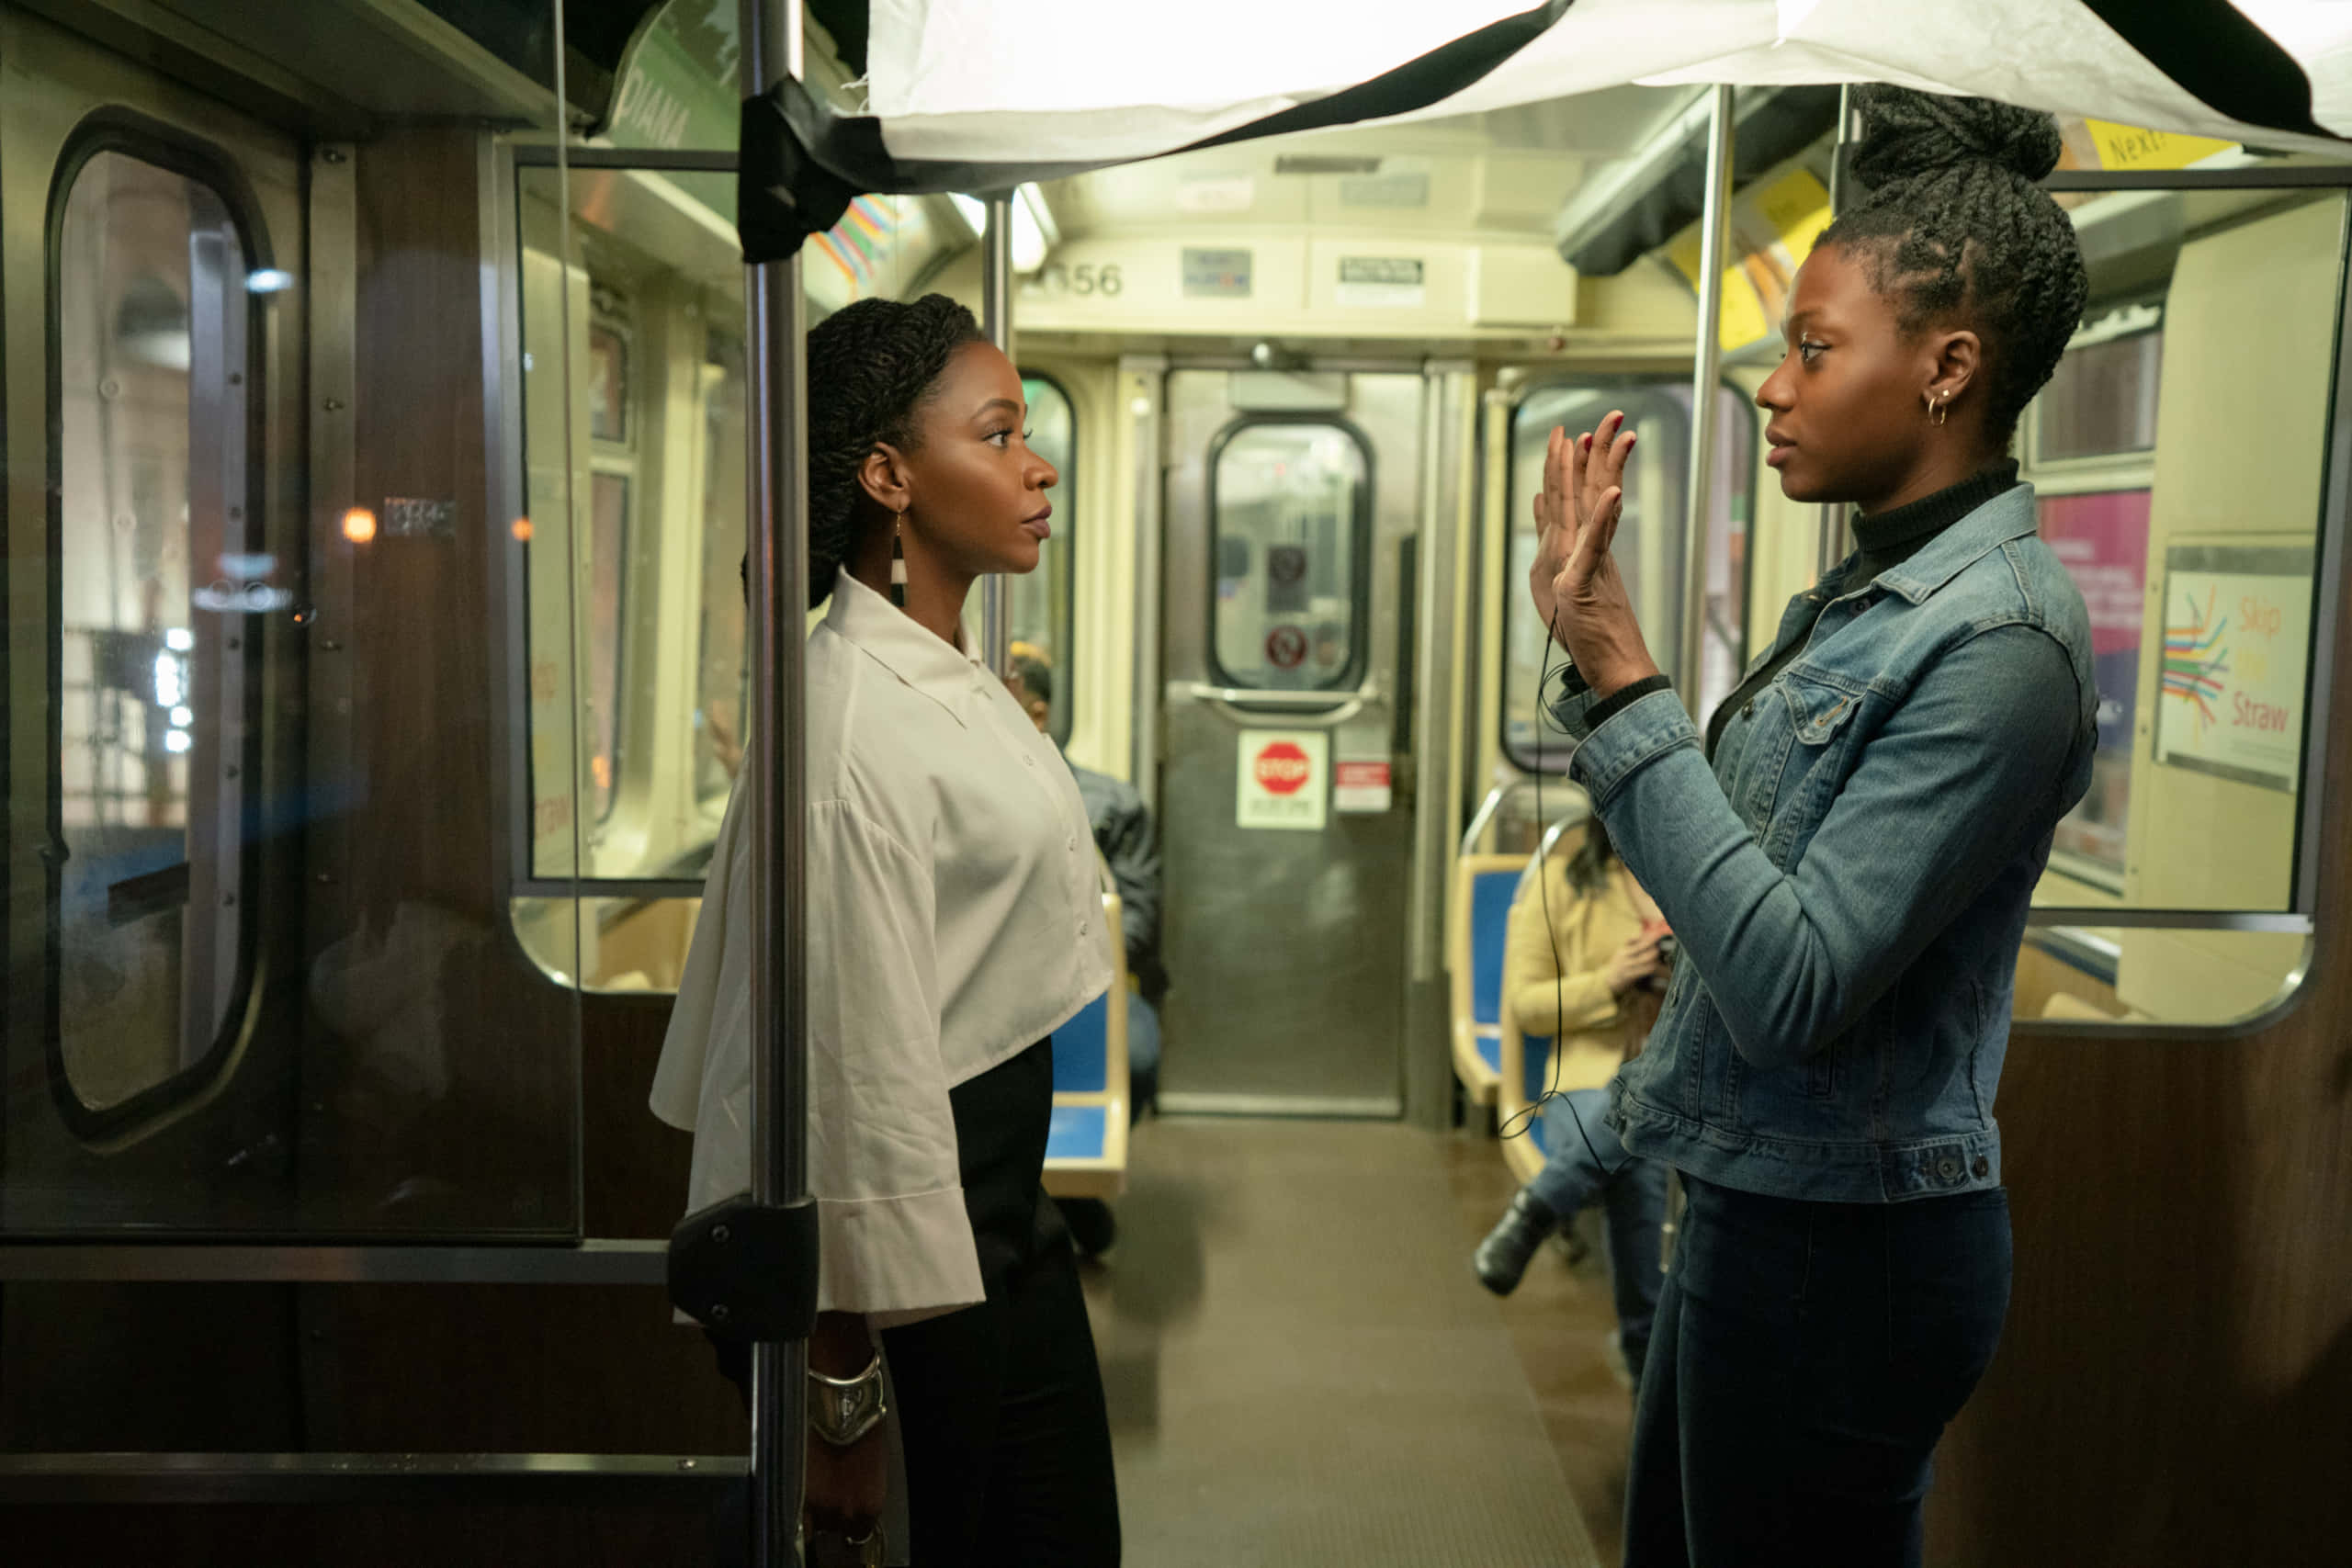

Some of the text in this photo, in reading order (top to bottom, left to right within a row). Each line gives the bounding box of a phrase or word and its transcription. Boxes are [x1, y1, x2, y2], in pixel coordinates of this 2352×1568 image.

[2237, 595, 2282, 640] Skip
[2233, 691, 2289, 733] Straw
[1257, 757, 1308, 780] STOP
